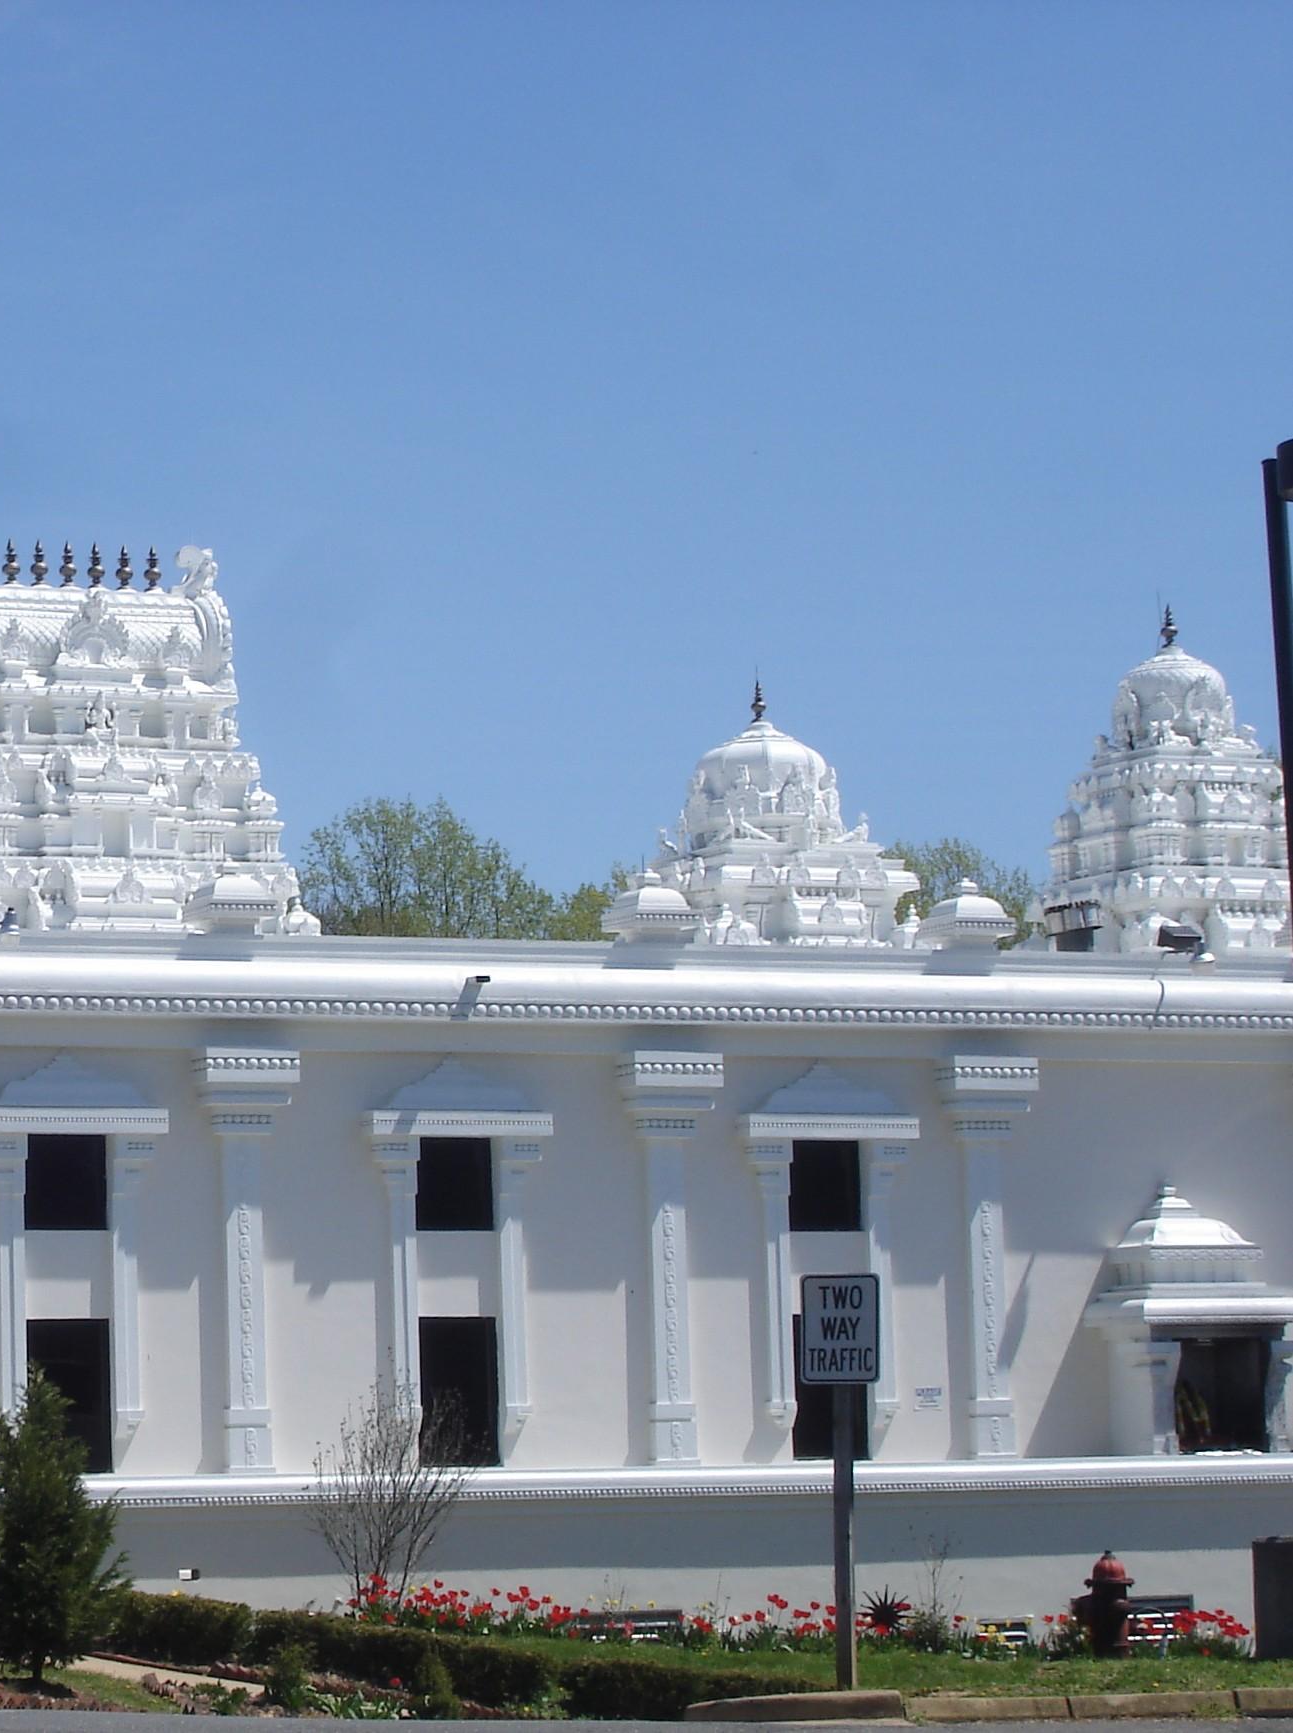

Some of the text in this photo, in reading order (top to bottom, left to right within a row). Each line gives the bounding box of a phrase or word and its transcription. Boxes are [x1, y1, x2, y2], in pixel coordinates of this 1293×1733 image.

[818, 1285, 862, 1310] TWO
[820, 1316, 861, 1341] WAY
[808, 1347, 874, 1373] TRAFFIC
